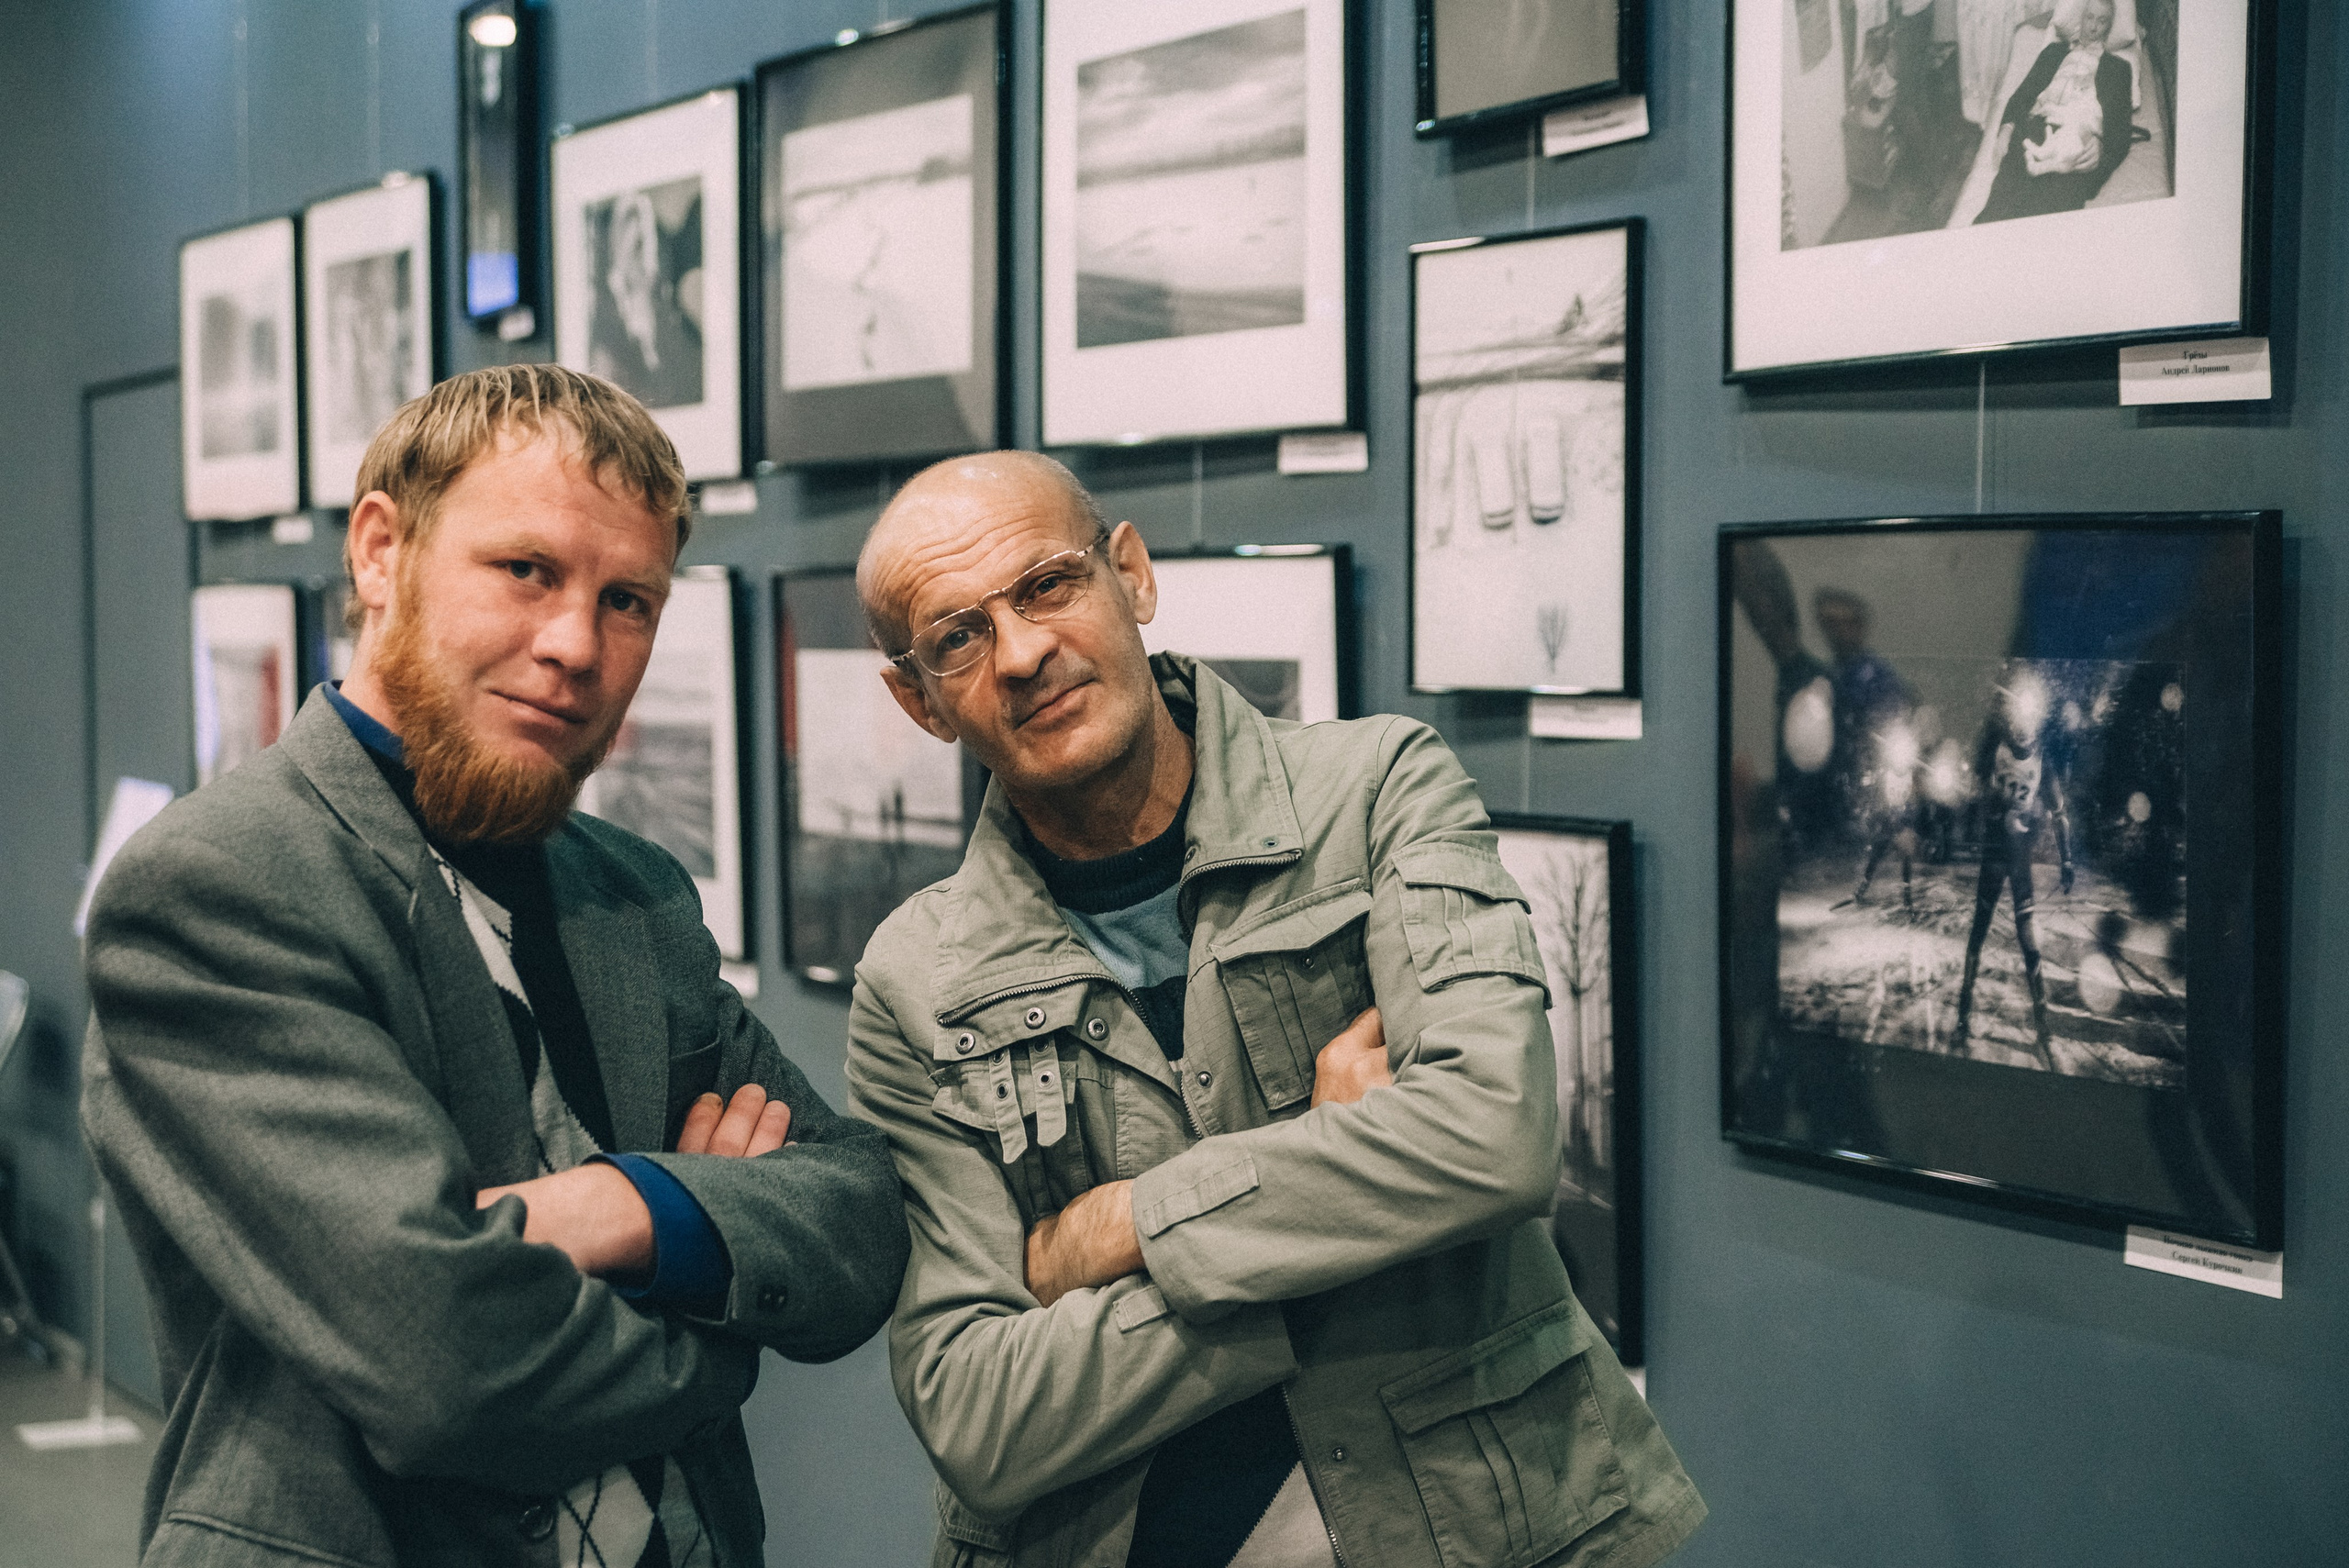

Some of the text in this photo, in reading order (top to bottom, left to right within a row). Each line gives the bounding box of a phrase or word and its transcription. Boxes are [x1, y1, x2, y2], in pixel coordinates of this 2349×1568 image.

[2162, 364, 2231, 376] Андрей Ларионов
[2172, 1251, 2200, 1265] Сергей
